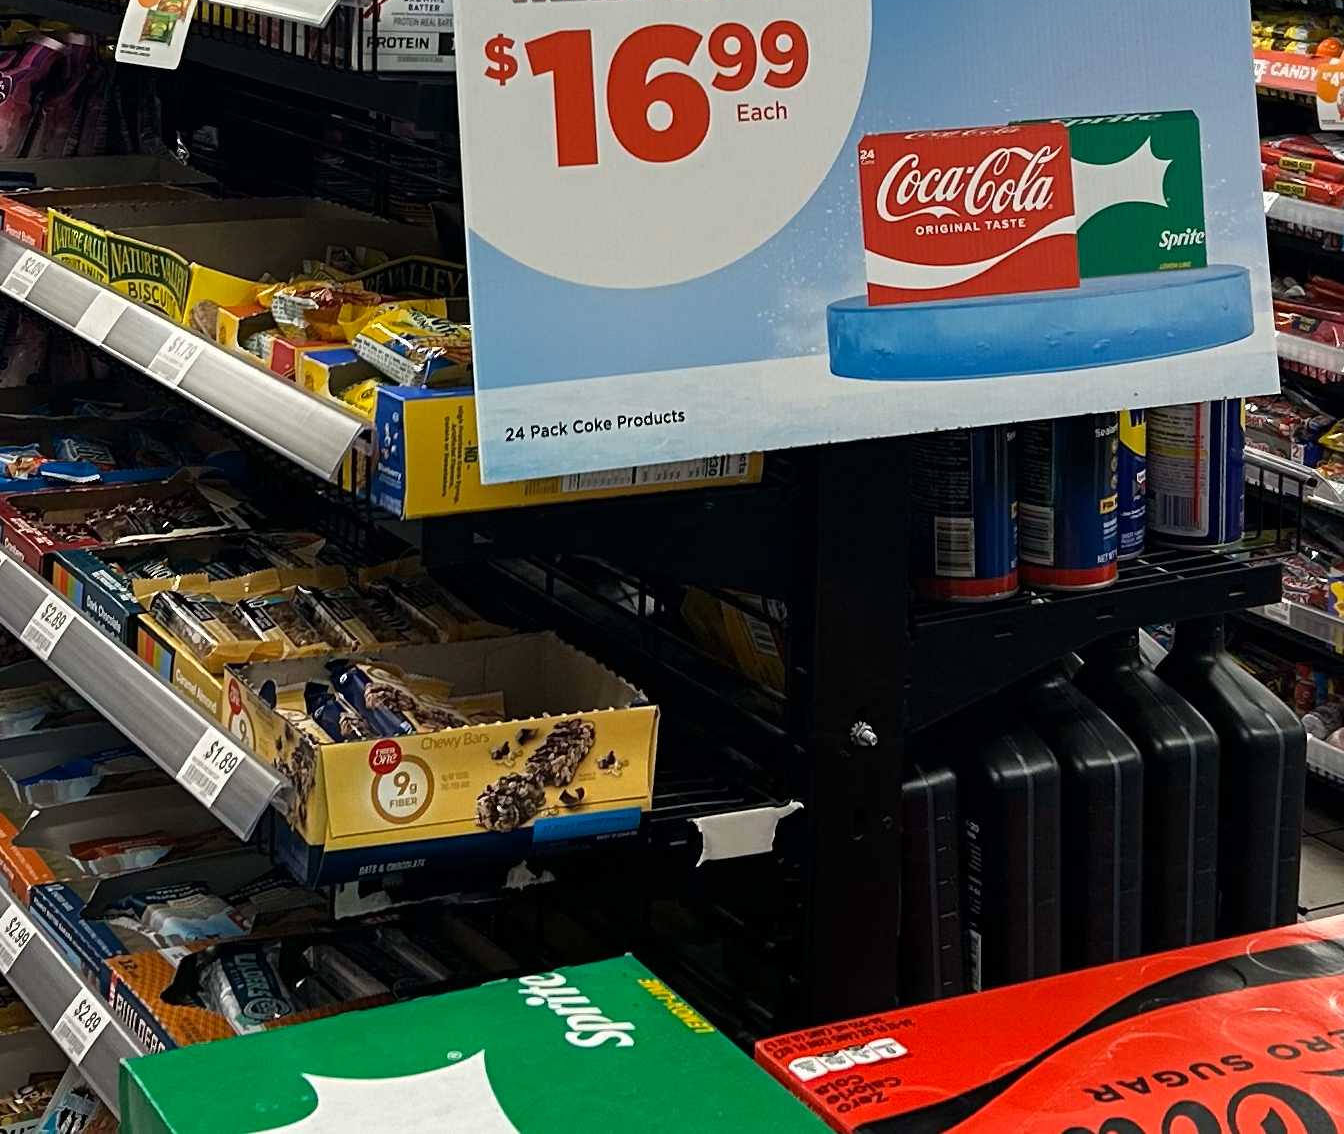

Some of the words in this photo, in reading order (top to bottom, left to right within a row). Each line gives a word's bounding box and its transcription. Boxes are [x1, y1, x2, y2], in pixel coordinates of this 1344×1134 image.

[408, 3, 441, 12] BATTER
[366, 36, 430, 50] PROTEIN
[1270, 62, 1319, 83] CANDY
[737, 101, 788, 122] Each
[860, 149, 876, 160] 24
[876, 145, 1064, 222] Coca-Cola
[915, 220, 981, 236] ORIGINAL
[985, 218, 1027, 231] TASTE
[1158, 227, 1205, 251] Sprite
[112, 245, 154, 282] NATURE
[166, 334, 197, 361] $1.79
[505, 426, 525, 442] 24
[530, 421, 568, 439] Pack
[572, 417, 612, 434] Coke
[617, 409, 686, 429] Products
[42, 602, 69, 629] $2.89
[375, 746, 396, 756] FIBER
[421, 734, 462, 751] Chewy
[463, 731, 490, 746] Bars
[206, 741, 239, 774] $1.89
[373, 753, 398, 767] One
[393, 771, 418, 797] 9g
[389, 796, 418, 809] FIBER
[6, 916, 31, 947] $2.99
[74, 997, 104, 1029] $2.89
[517, 972, 636, 1049] Sprite
[637, 977, 716, 1035] LEMON-LIME
[826, 1076, 902, 1106] Calorie
[1083, 1052, 1256, 1104] SUGAR
[836, 1091, 890, 1114] Zero
